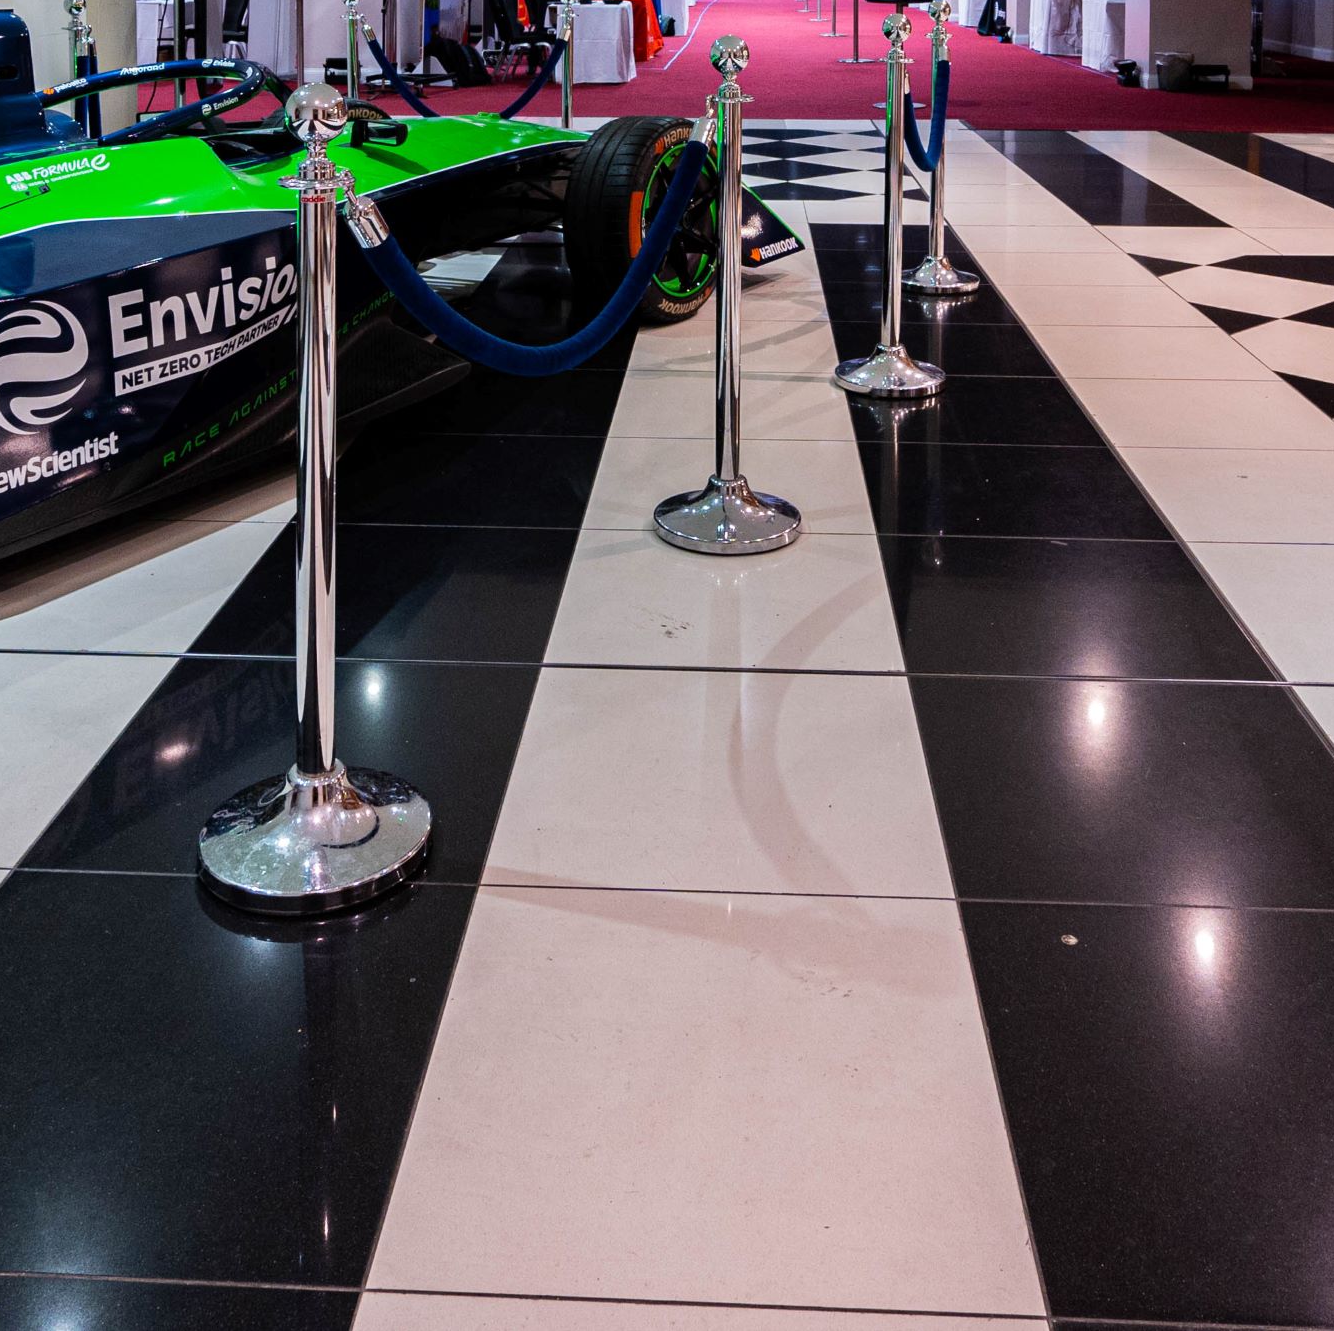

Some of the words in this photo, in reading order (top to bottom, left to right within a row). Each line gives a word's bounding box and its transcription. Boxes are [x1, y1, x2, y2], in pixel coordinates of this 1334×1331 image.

[213, 97, 239, 111] Envision
[5, 171, 32, 184] ABB
[122, 366, 154, 390] NET
[159, 353, 201, 378] ZERO
[204, 341, 235, 364] TECH
[237, 315, 280, 348] PARTNER
[163, 421, 220, 468] RACE
[230, 369, 297, 423] AGAINST
